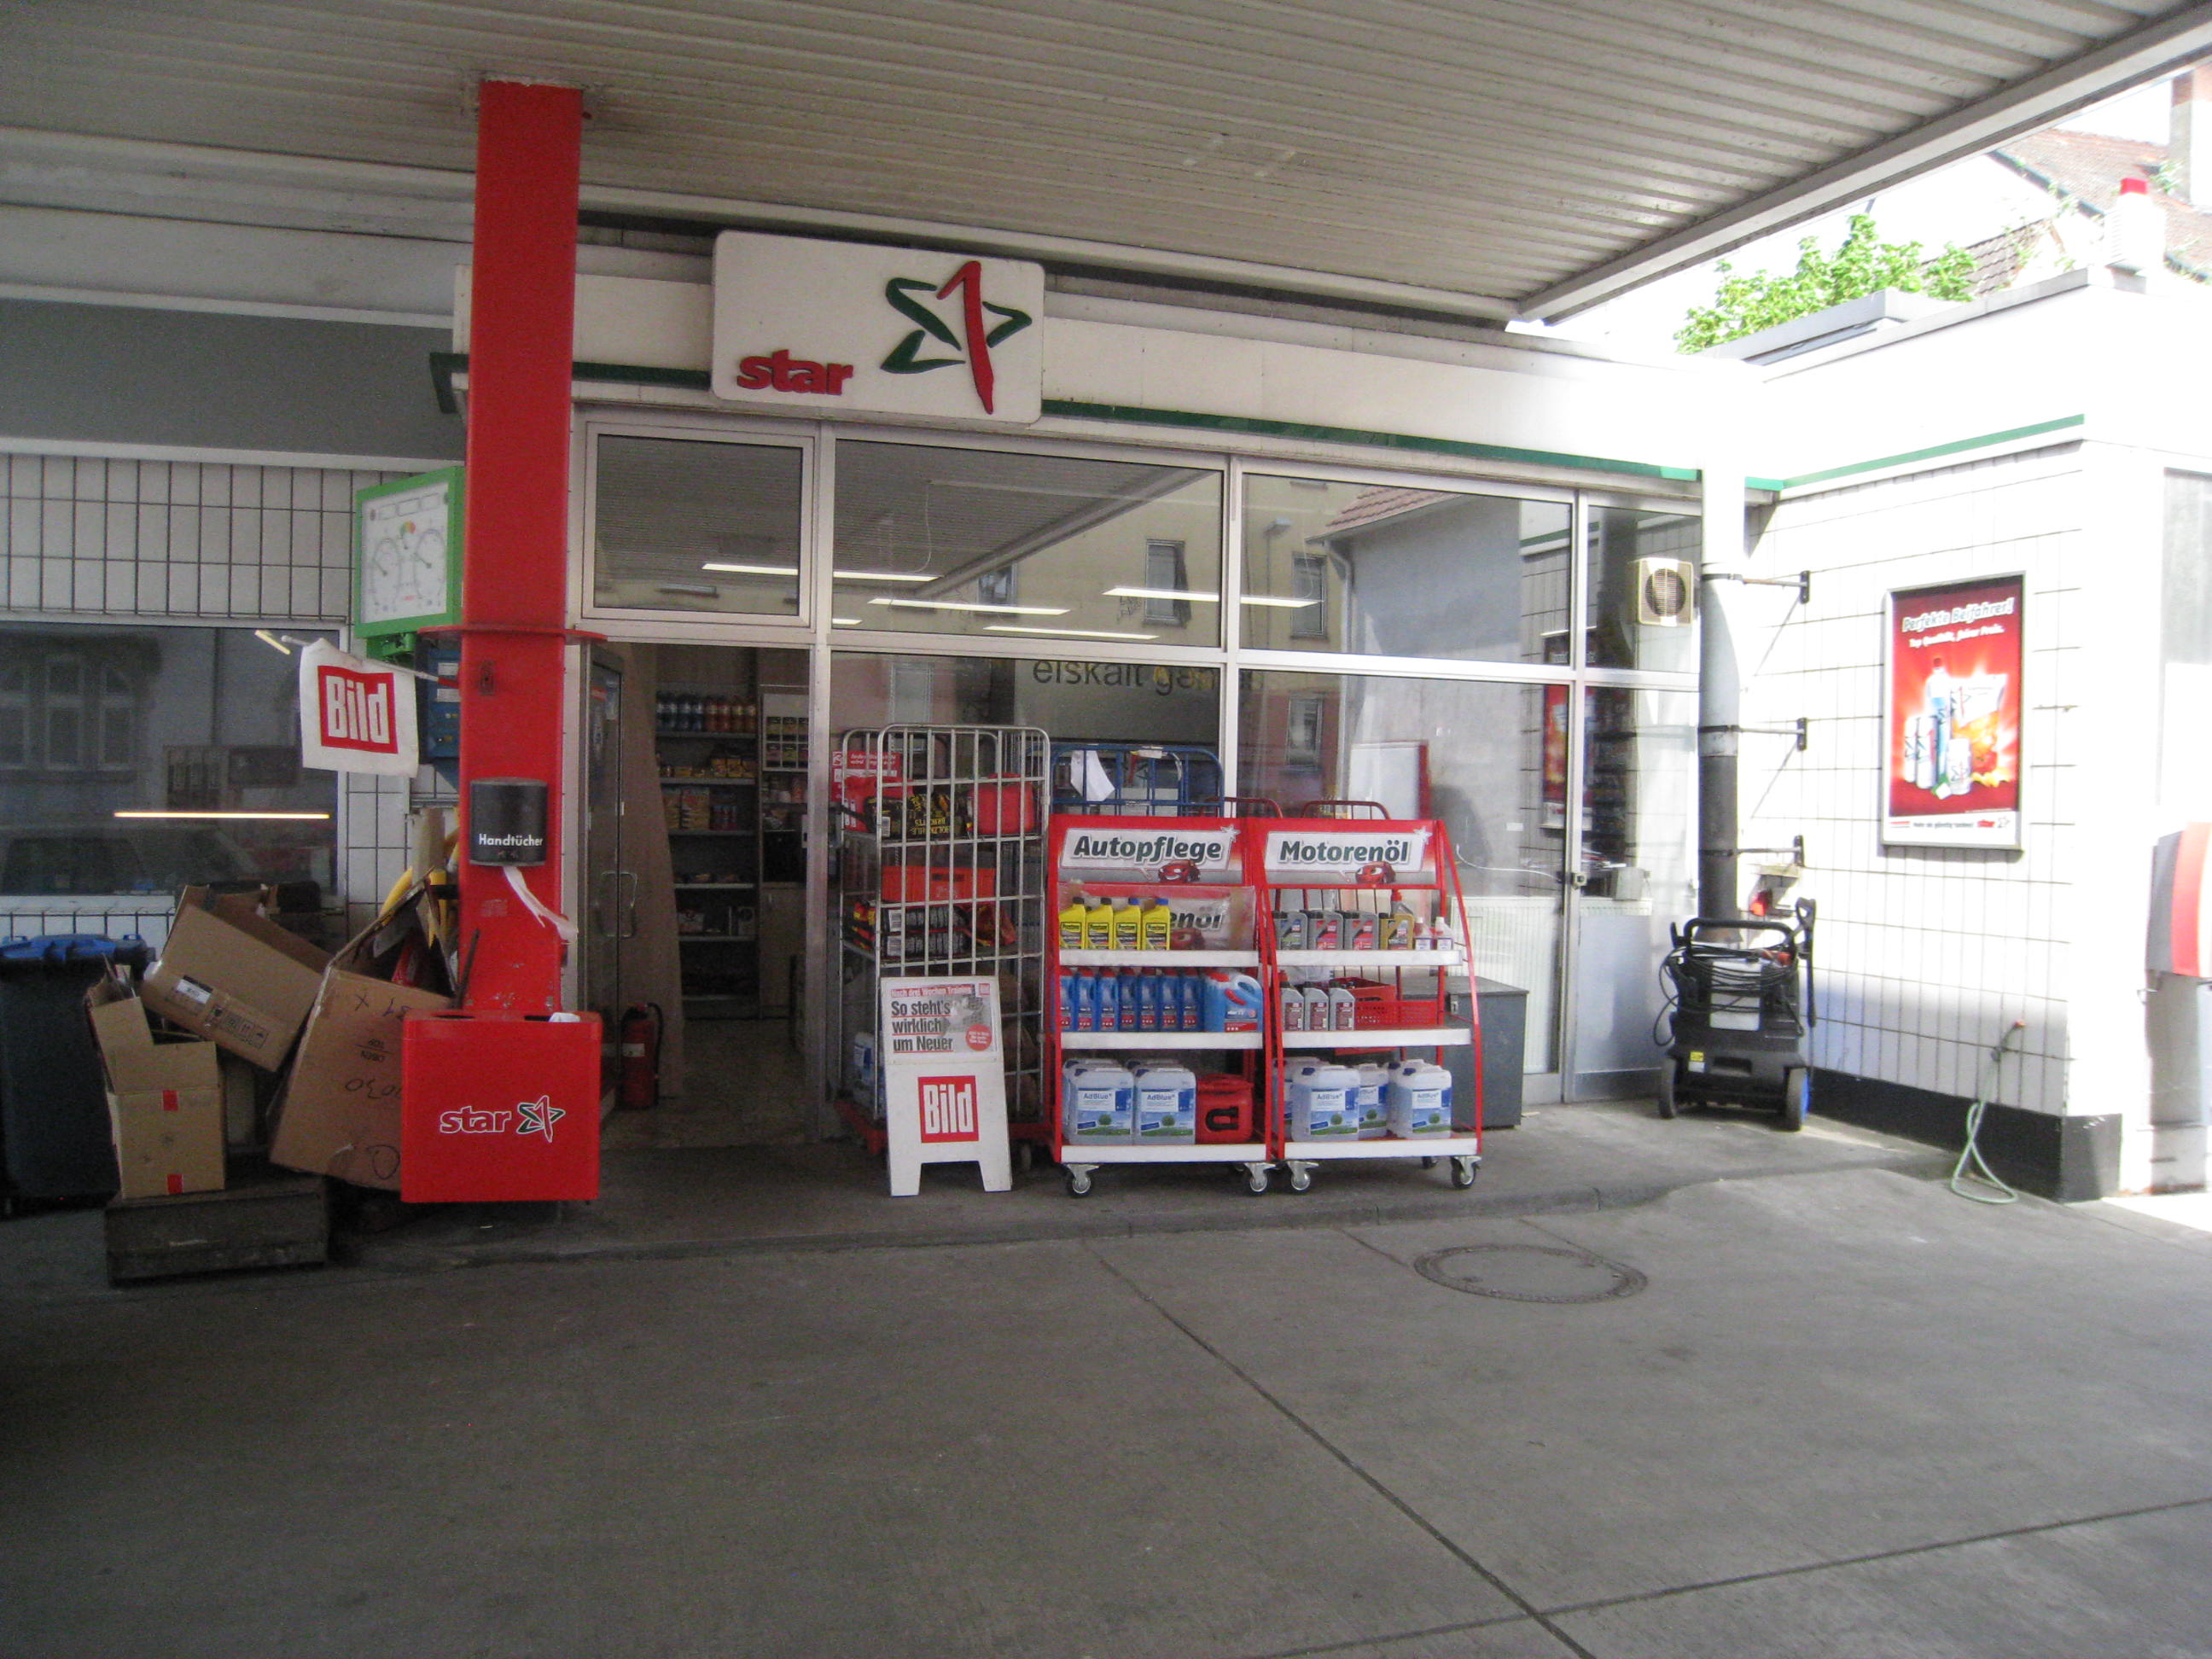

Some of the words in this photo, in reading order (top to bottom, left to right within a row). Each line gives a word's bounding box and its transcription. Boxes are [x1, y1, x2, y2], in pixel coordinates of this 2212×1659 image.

[736, 349, 854, 396] star
[1901, 610, 1952, 633] Perfekte
[1951, 597, 2015, 624] Beifahrer!
[325, 674, 391, 744] Bild
[479, 833, 544, 847] Handtücher
[1073, 835, 1222, 863] Autopflege
[1279, 839, 1409, 862] Motorenöl
[891, 1001, 909, 1016] So
[911, 999, 951, 1016] steht's
[892, 1017, 942, 1034] wirklich
[893, 1038, 913, 1051] um
[916, 1035, 953, 1051] Neuer
[439, 1105, 513, 1134] star
[923, 1083, 975, 1134] Bild
